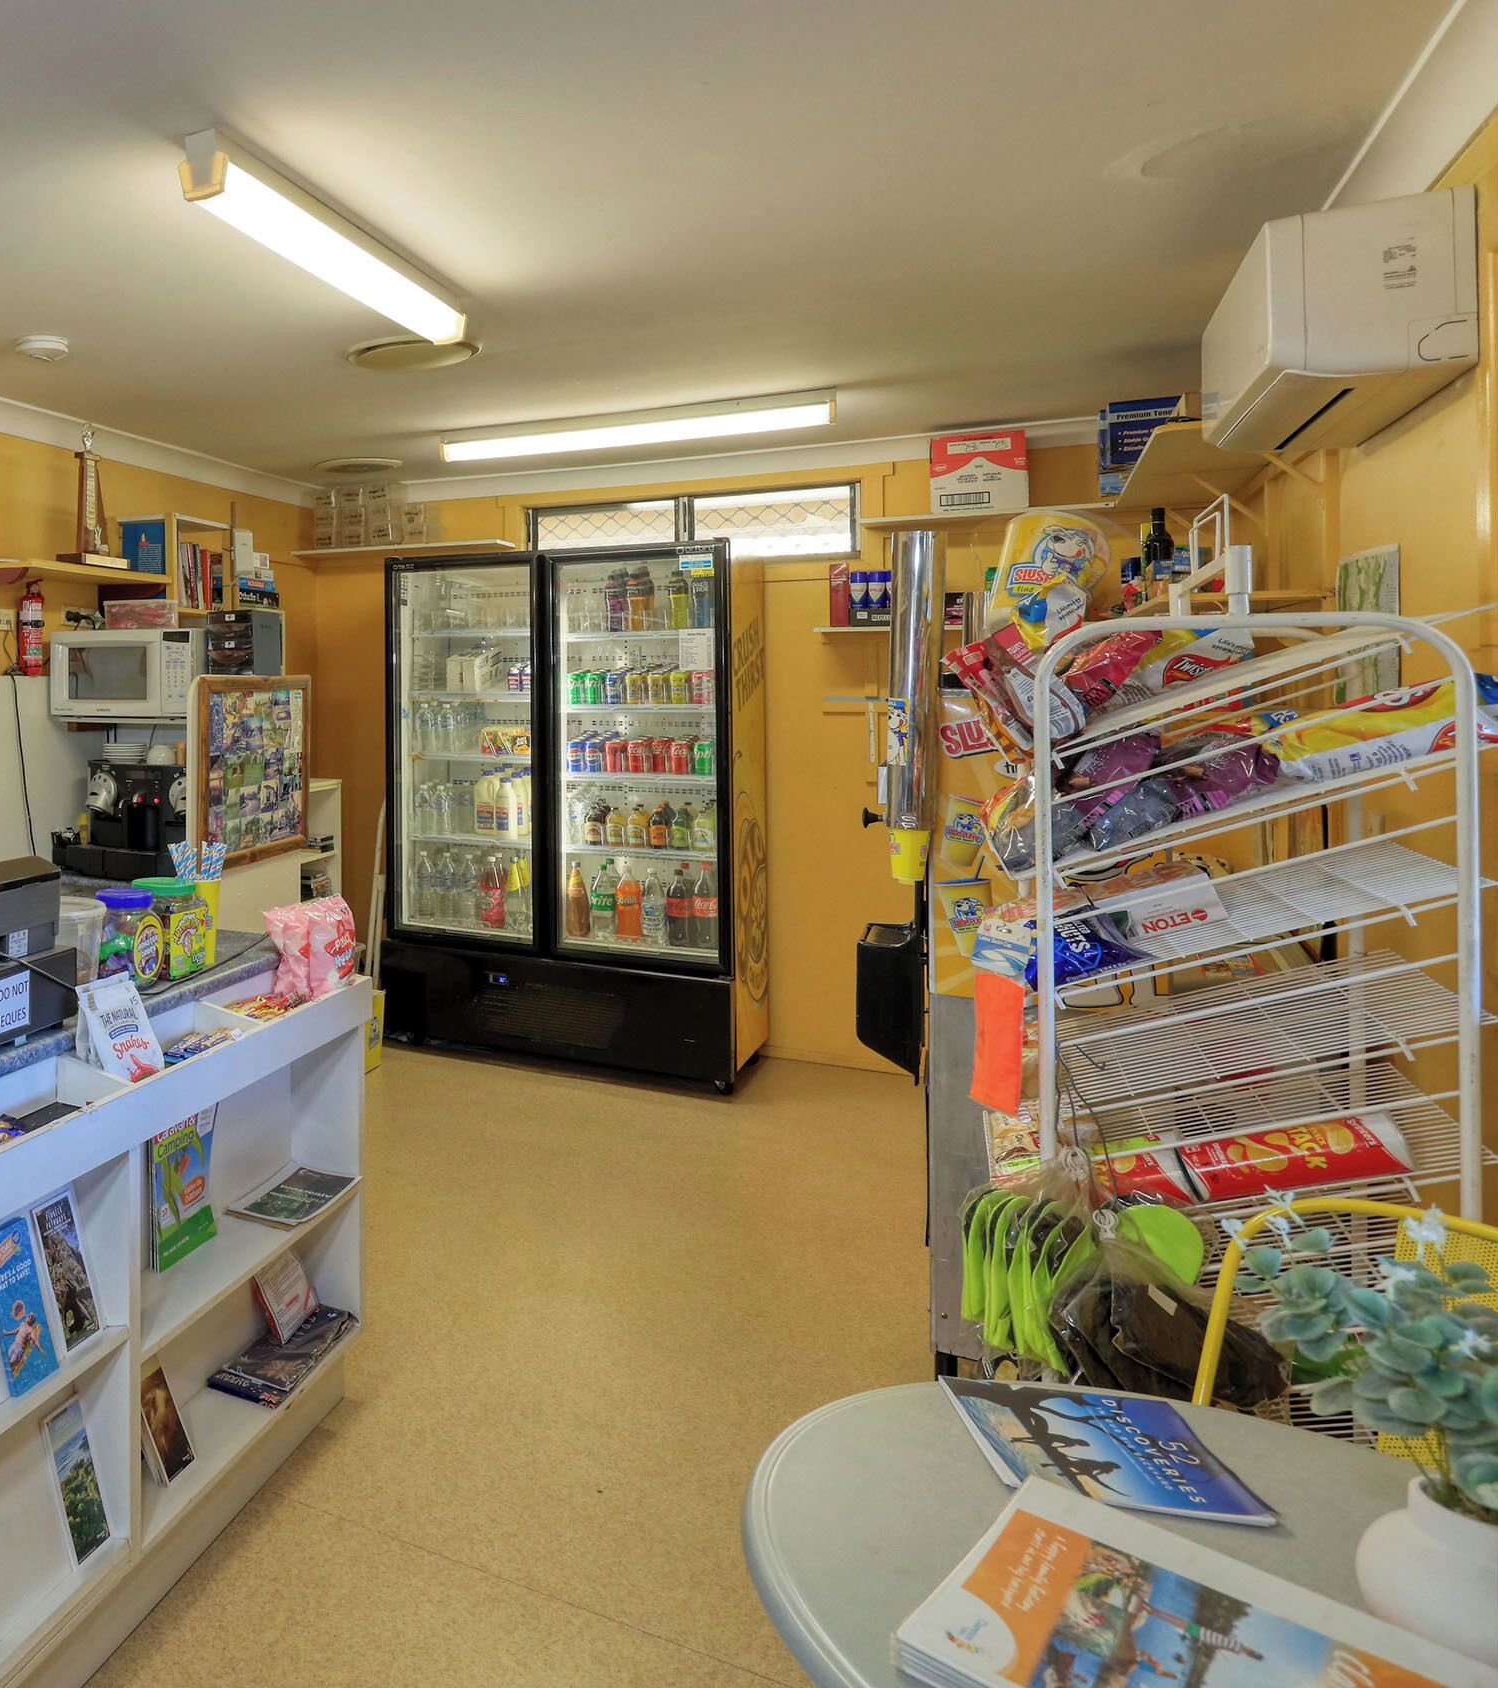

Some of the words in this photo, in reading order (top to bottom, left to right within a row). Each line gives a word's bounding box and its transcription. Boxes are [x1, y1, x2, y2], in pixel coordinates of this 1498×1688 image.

[1117, 411, 1151, 420] Premium
[1154, 408, 1173, 417] Tone
[940, 719, 997, 755] SLU
[1141, 910, 1193, 935] ETON
[11, 979, 30, 998] NOT
[100, 1014, 113, 1029] THE
[111, 1007, 139, 1025] NATURAL
[112, 1035, 151, 1060] Snakes
[157, 1130, 195, 1159] Camping
[1288, 1125, 1329, 1170] TACK
[15, 1259, 32, 1272] GOOD
[16, 1267, 31, 1282] SAVE!
[1101, 1398, 1207, 1504] DISCOVERIES
[1158, 1440, 1200, 1465] 52
